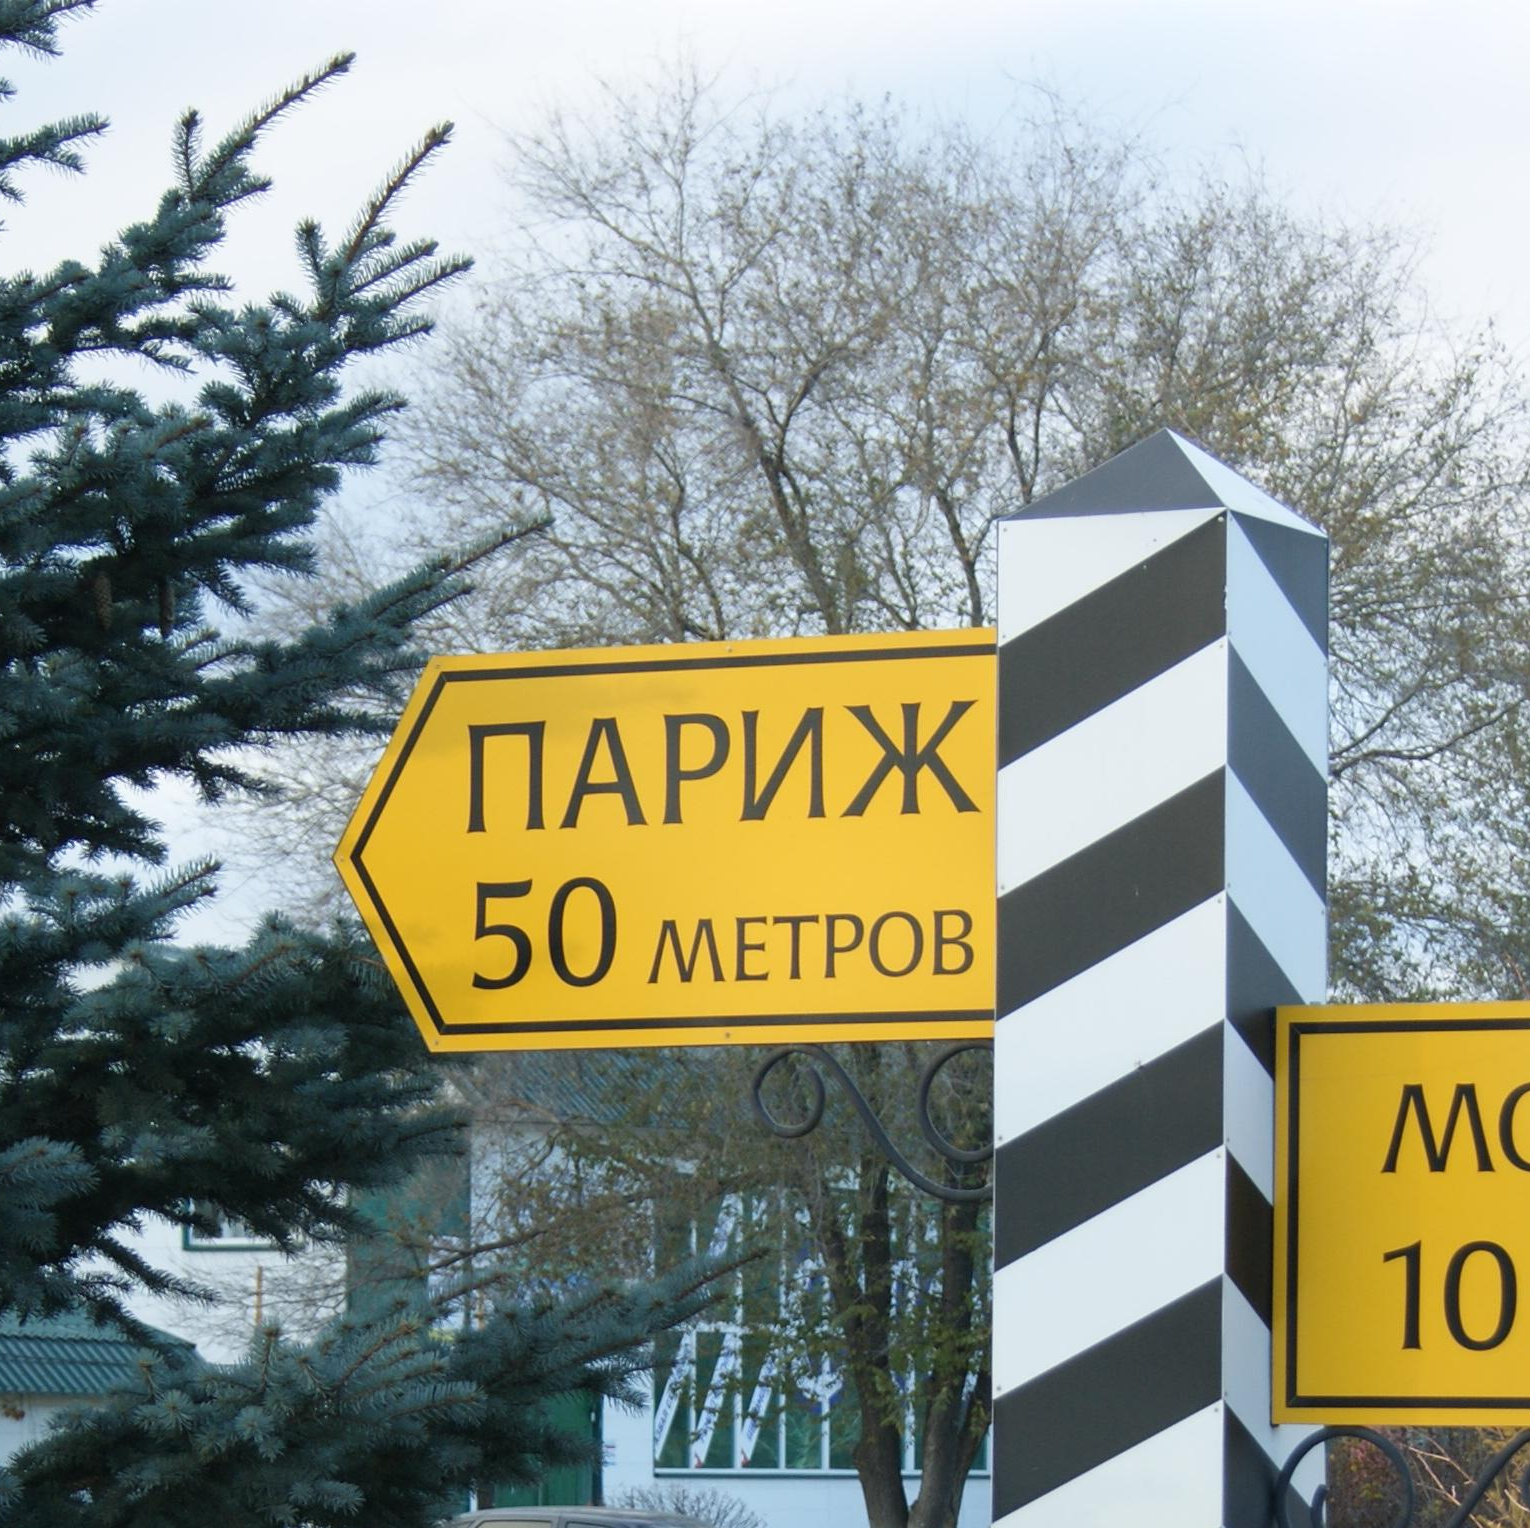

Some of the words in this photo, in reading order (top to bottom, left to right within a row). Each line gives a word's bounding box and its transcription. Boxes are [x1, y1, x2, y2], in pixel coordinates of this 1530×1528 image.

[467, 700, 980, 834] ПАРИЖ
[472, 877, 617, 990] 50
[648, 909, 974, 984] МЕТРОВ
